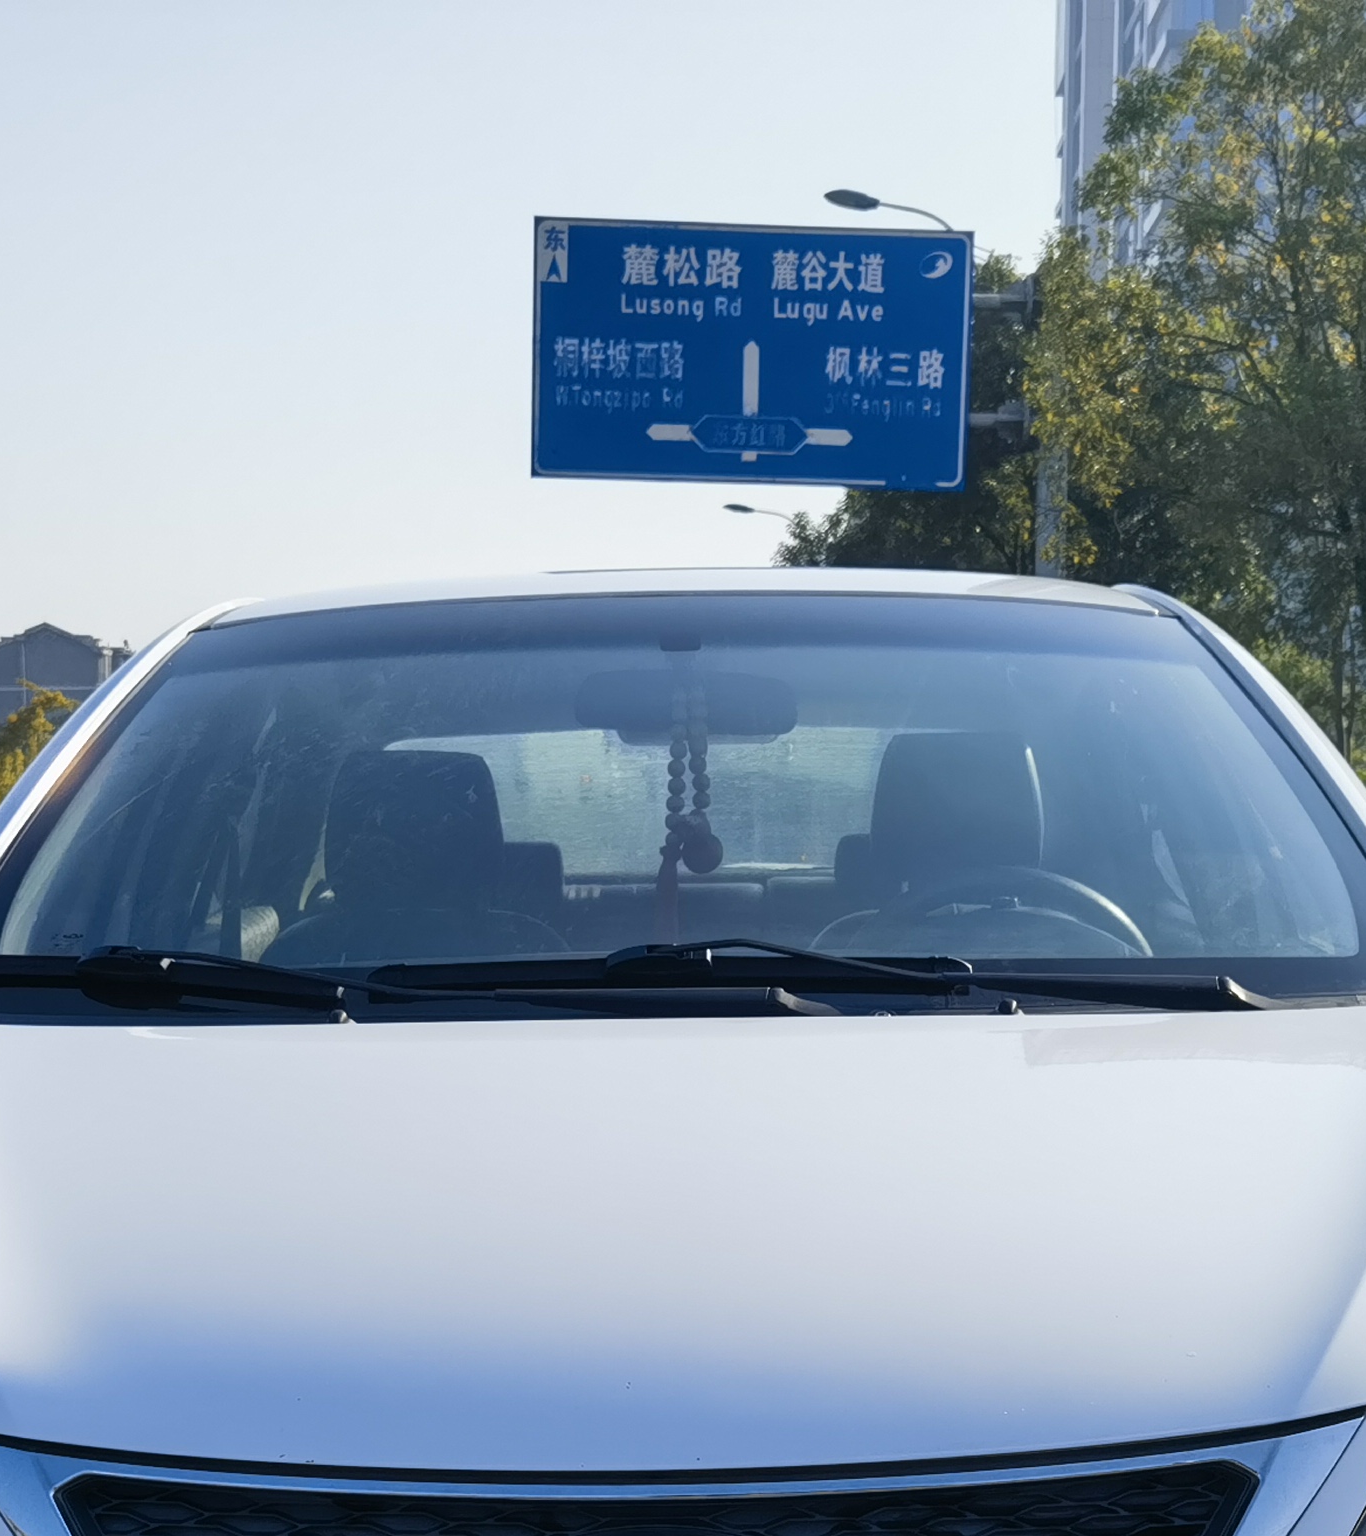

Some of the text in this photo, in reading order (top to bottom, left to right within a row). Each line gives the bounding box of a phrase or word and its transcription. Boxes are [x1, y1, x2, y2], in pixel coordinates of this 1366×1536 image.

[544, 226, 566, 252] 东
[621, 243, 742, 289] 麓松路
[771, 249, 885, 294] 麓谷大道
[621, 292, 742, 322] Lusong Rd
[773, 297, 884, 326] Lugu Ave
[554, 336, 684, 381] 桐梓坡西路
[825, 346, 945, 389] 枫林三路
